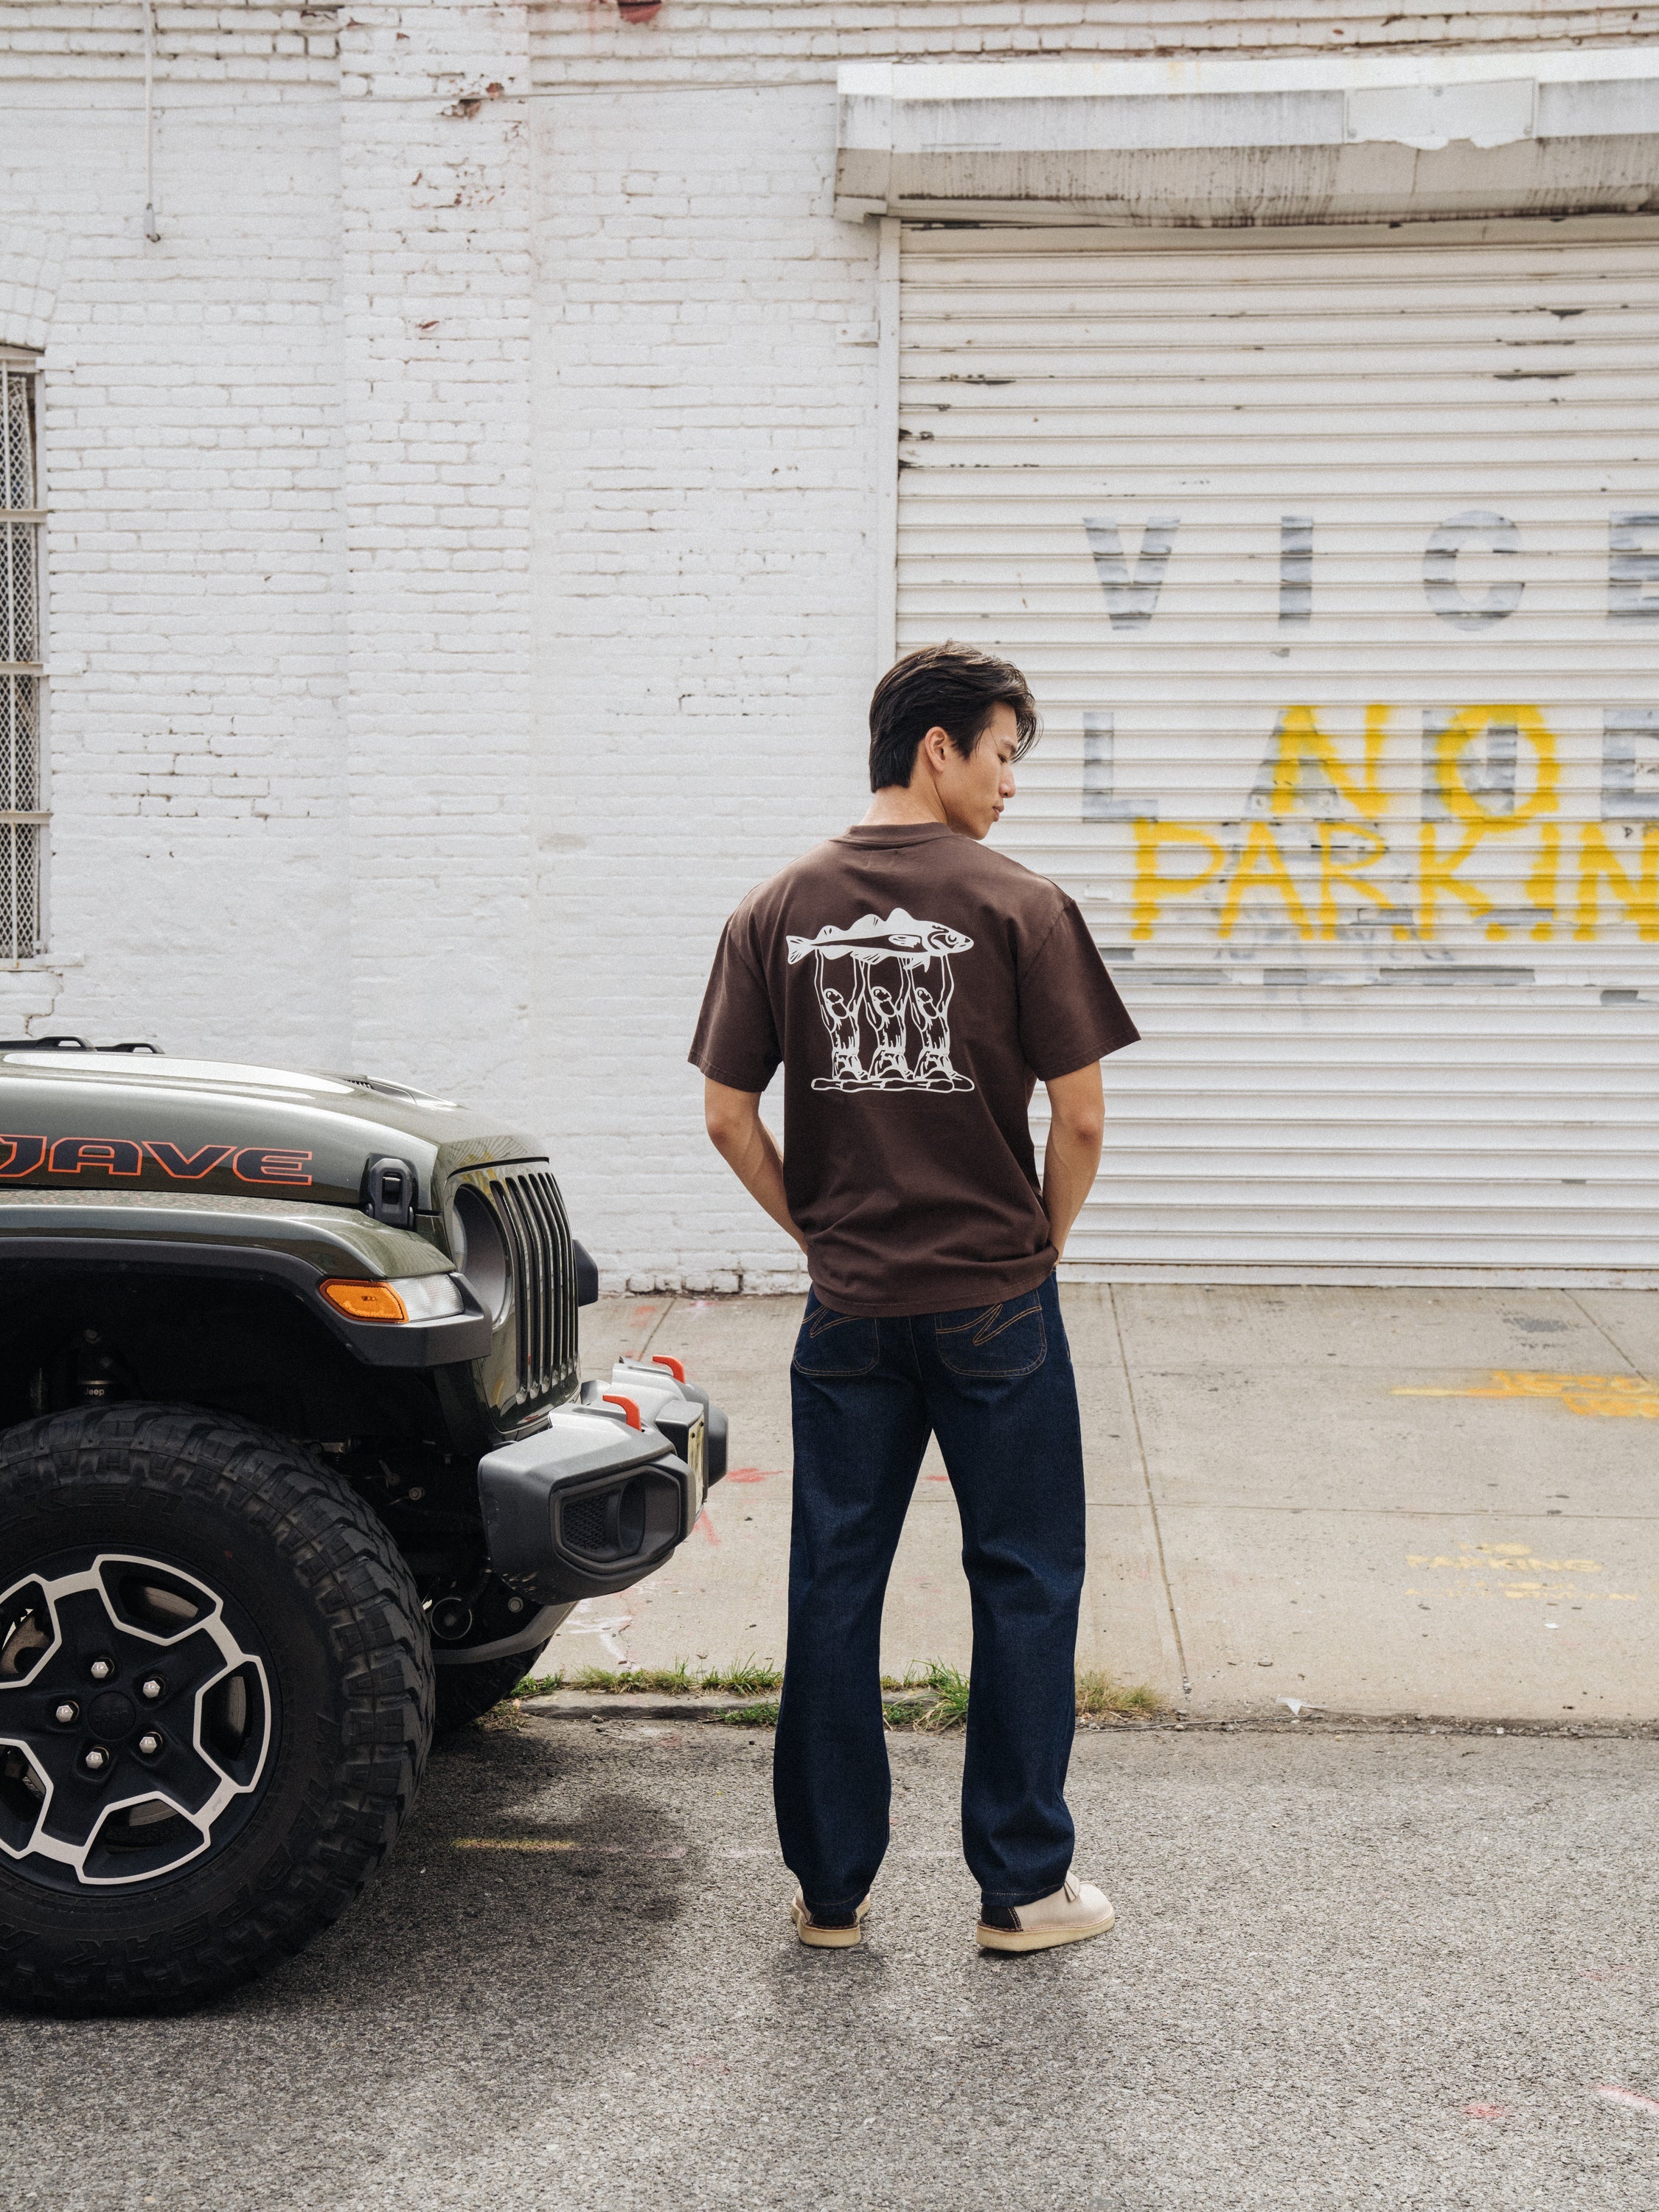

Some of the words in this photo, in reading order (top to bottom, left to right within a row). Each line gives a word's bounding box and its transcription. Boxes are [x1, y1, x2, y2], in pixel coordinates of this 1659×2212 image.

[1269, 703, 1562, 832] NO
[0, 1133, 313, 1186] JAVE
[83, 1387, 105, 1397] Jeep
[1404, 1554, 1604, 1573] PARKING
